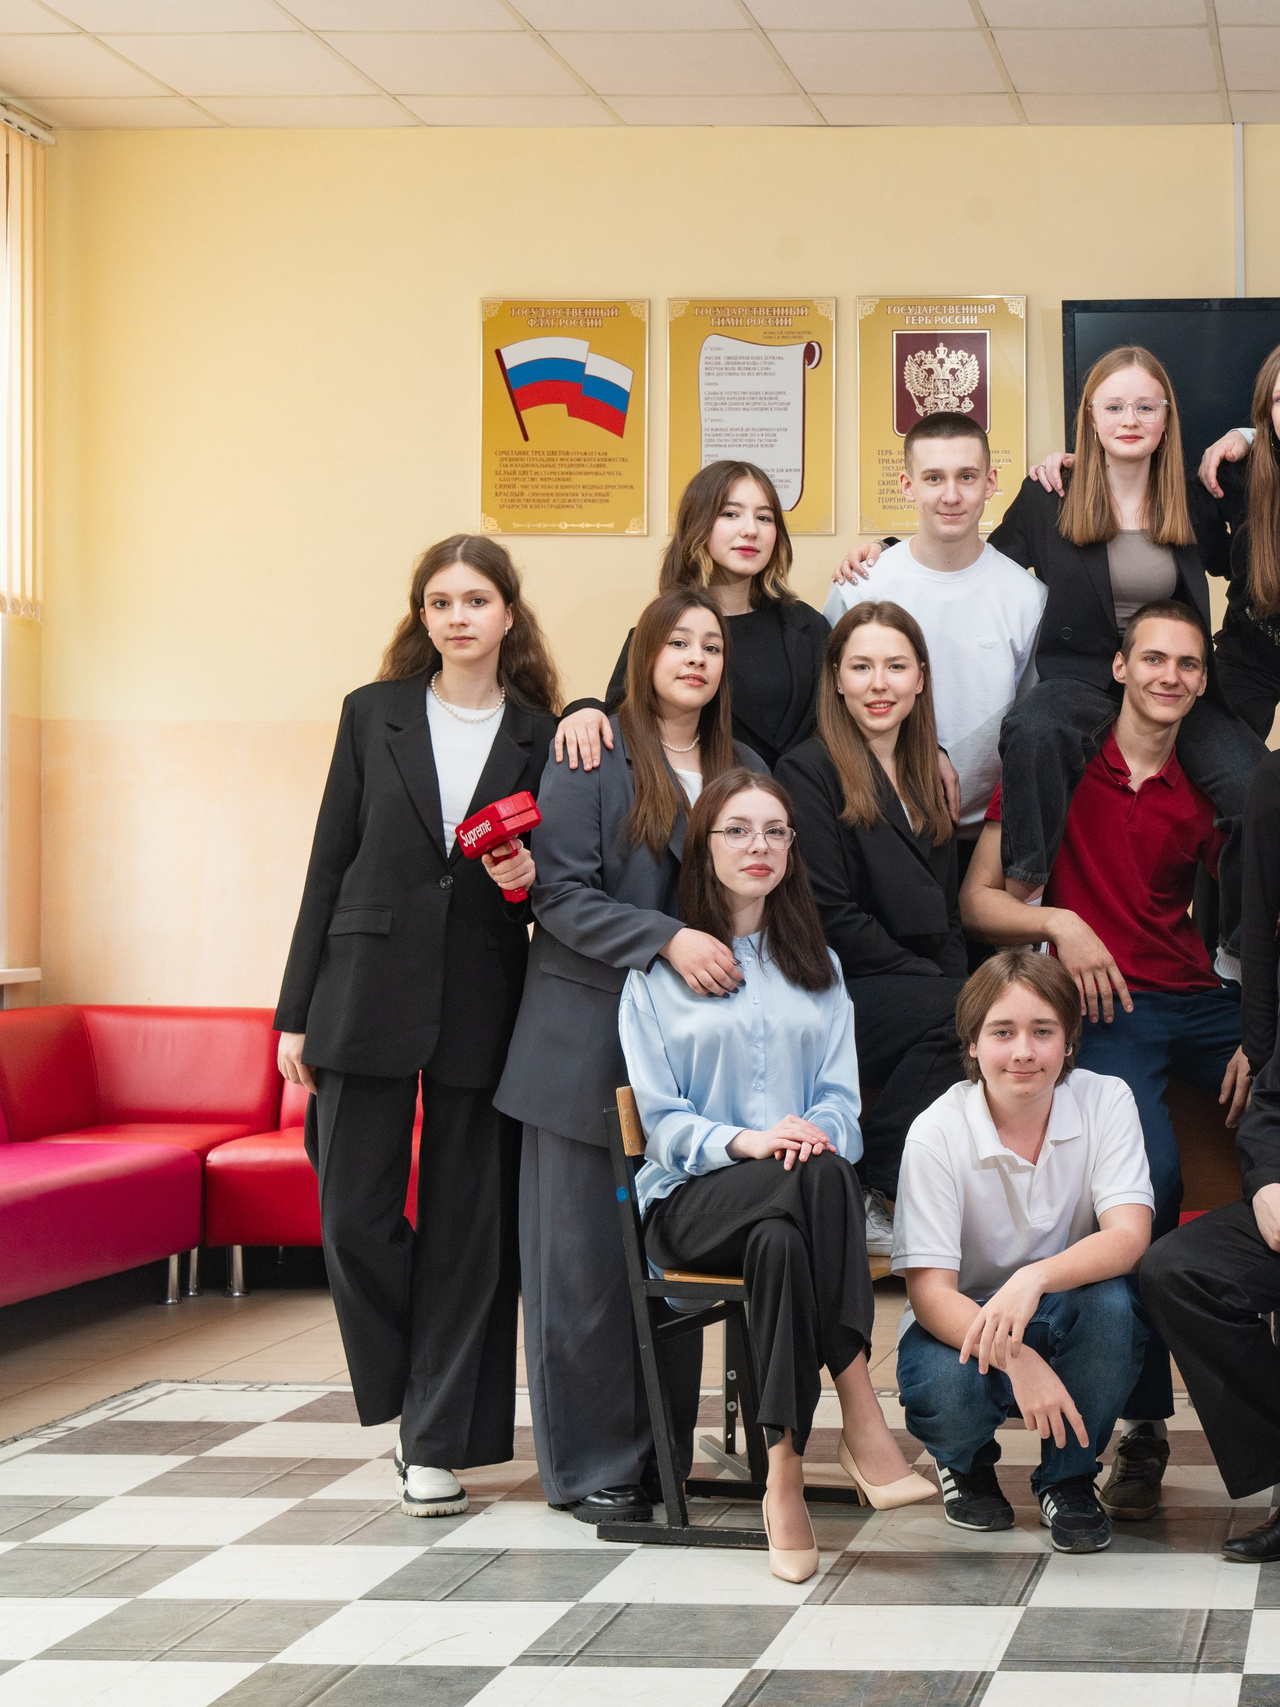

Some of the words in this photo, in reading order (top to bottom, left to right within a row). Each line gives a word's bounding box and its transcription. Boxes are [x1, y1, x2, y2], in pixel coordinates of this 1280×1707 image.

[511, 306, 619, 317] ГОСУДАРСТВЕННЫЙ
[694, 306, 809, 316] ГОСУДАРСТВЕННЫЙ
[886, 304, 996, 315] ГОСУДАРСТВЕННЫЙ
[527, 317, 556, 328] ФЛАГ
[558, 317, 603, 328] РОССИИ
[710, 317, 743, 327] ГИМН
[746, 317, 792, 327] РОССИИ
[905, 315, 931, 325] ГЕРБ
[934, 315, 978, 325] РОССИИ
[459, 820, 492, 847] Supreme
